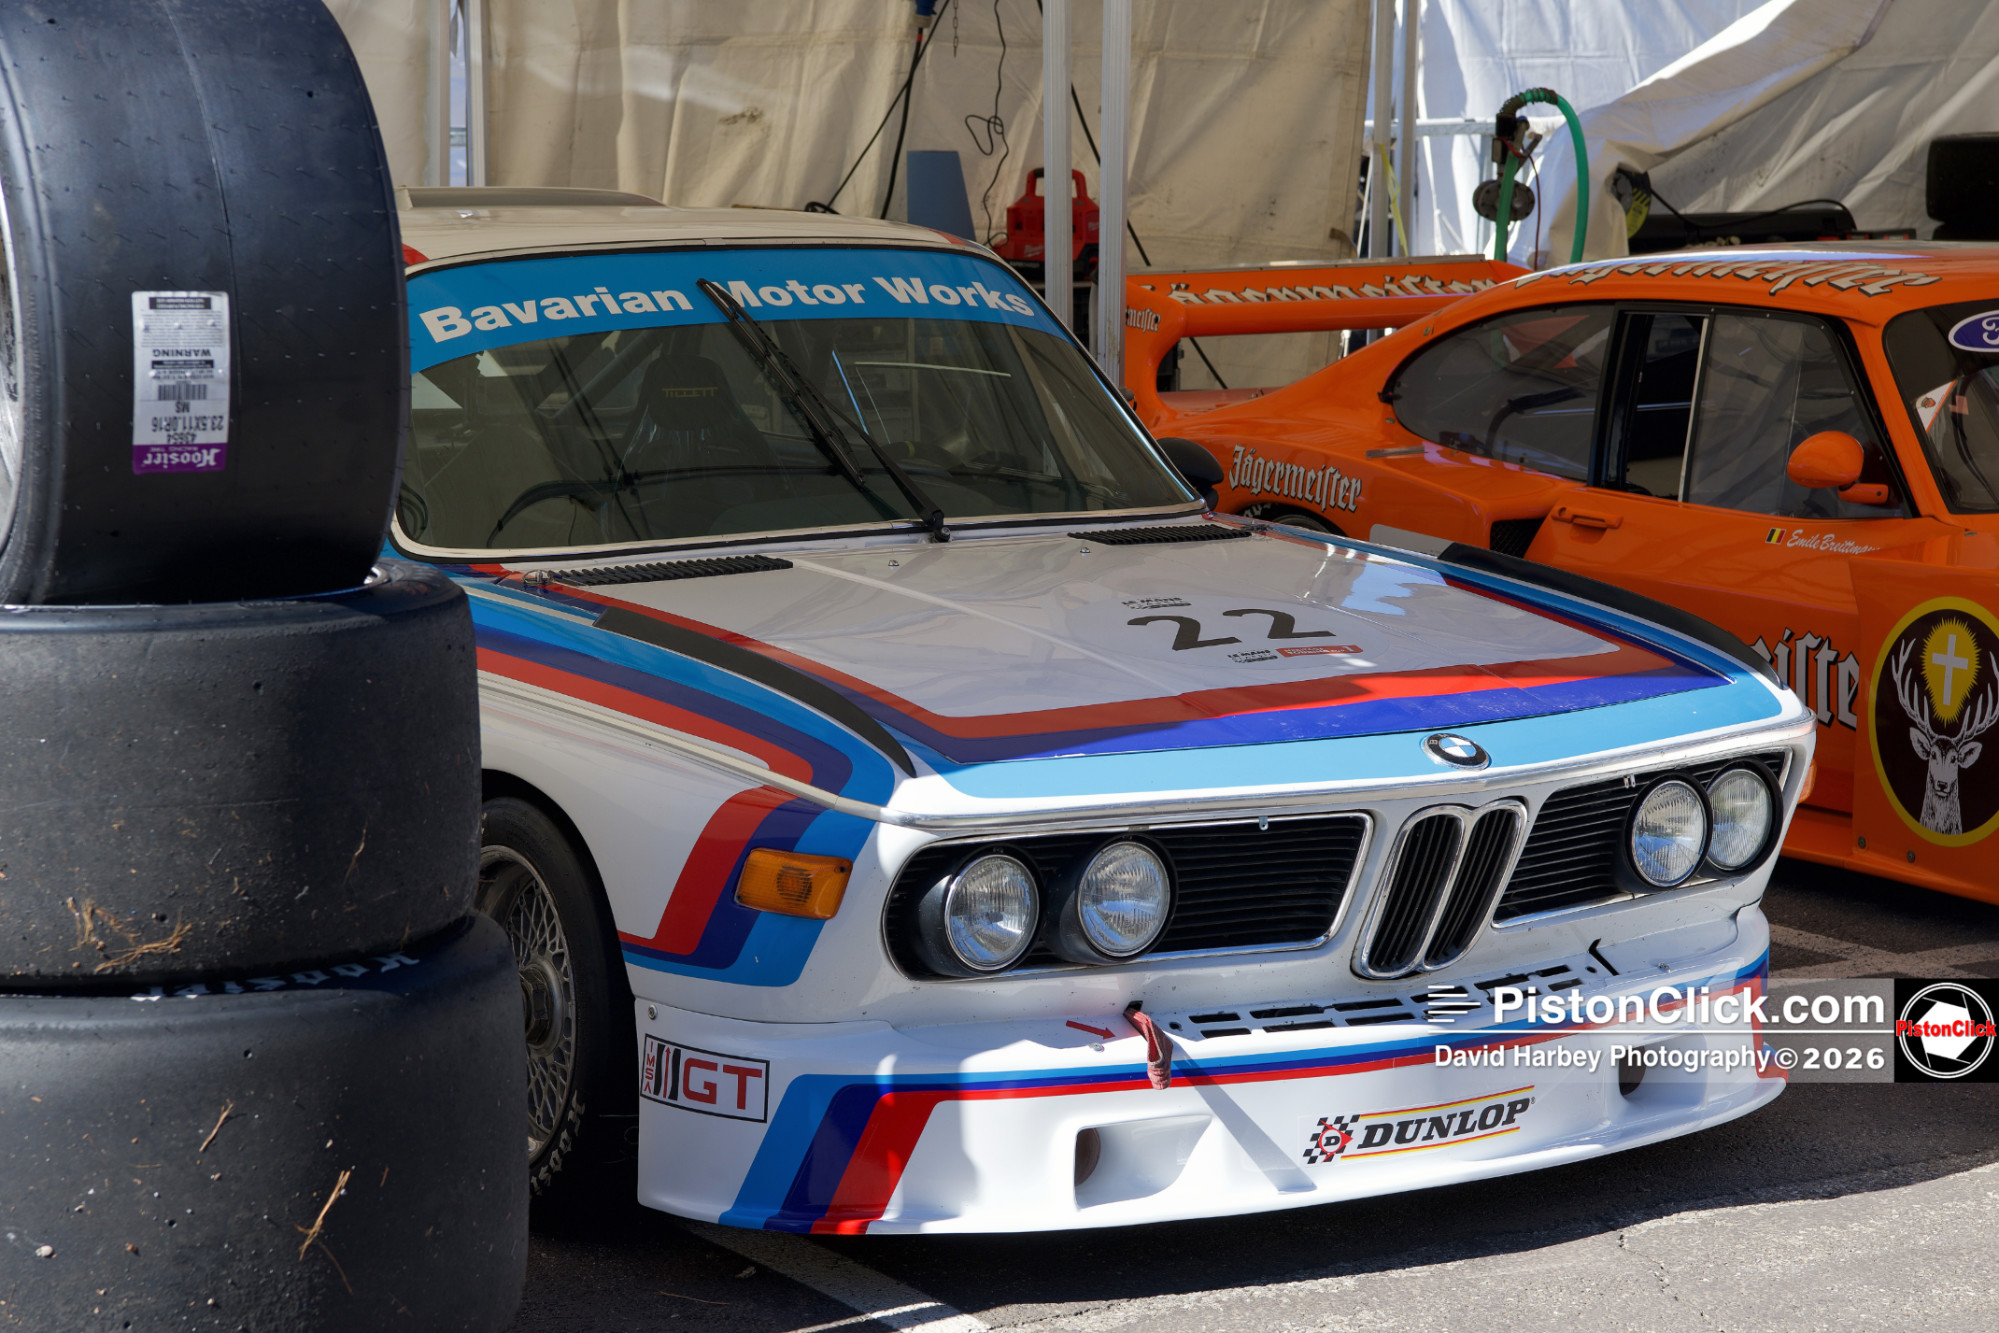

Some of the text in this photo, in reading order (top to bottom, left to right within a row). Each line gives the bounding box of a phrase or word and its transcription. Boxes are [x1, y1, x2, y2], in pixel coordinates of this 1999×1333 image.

[419, 276, 1034, 343] Bavarian Motor Works
[153, 349, 211, 357] WARNING
[175, 401, 190, 413] MS
[143, 448, 221, 469] Hoosier
[1787, 529, 1820, 549] Emile
[1127, 608, 1336, 651] 22
[683, 1057, 763, 1110] GT
[1357, 1097, 1531, 1150] DUNLOP
